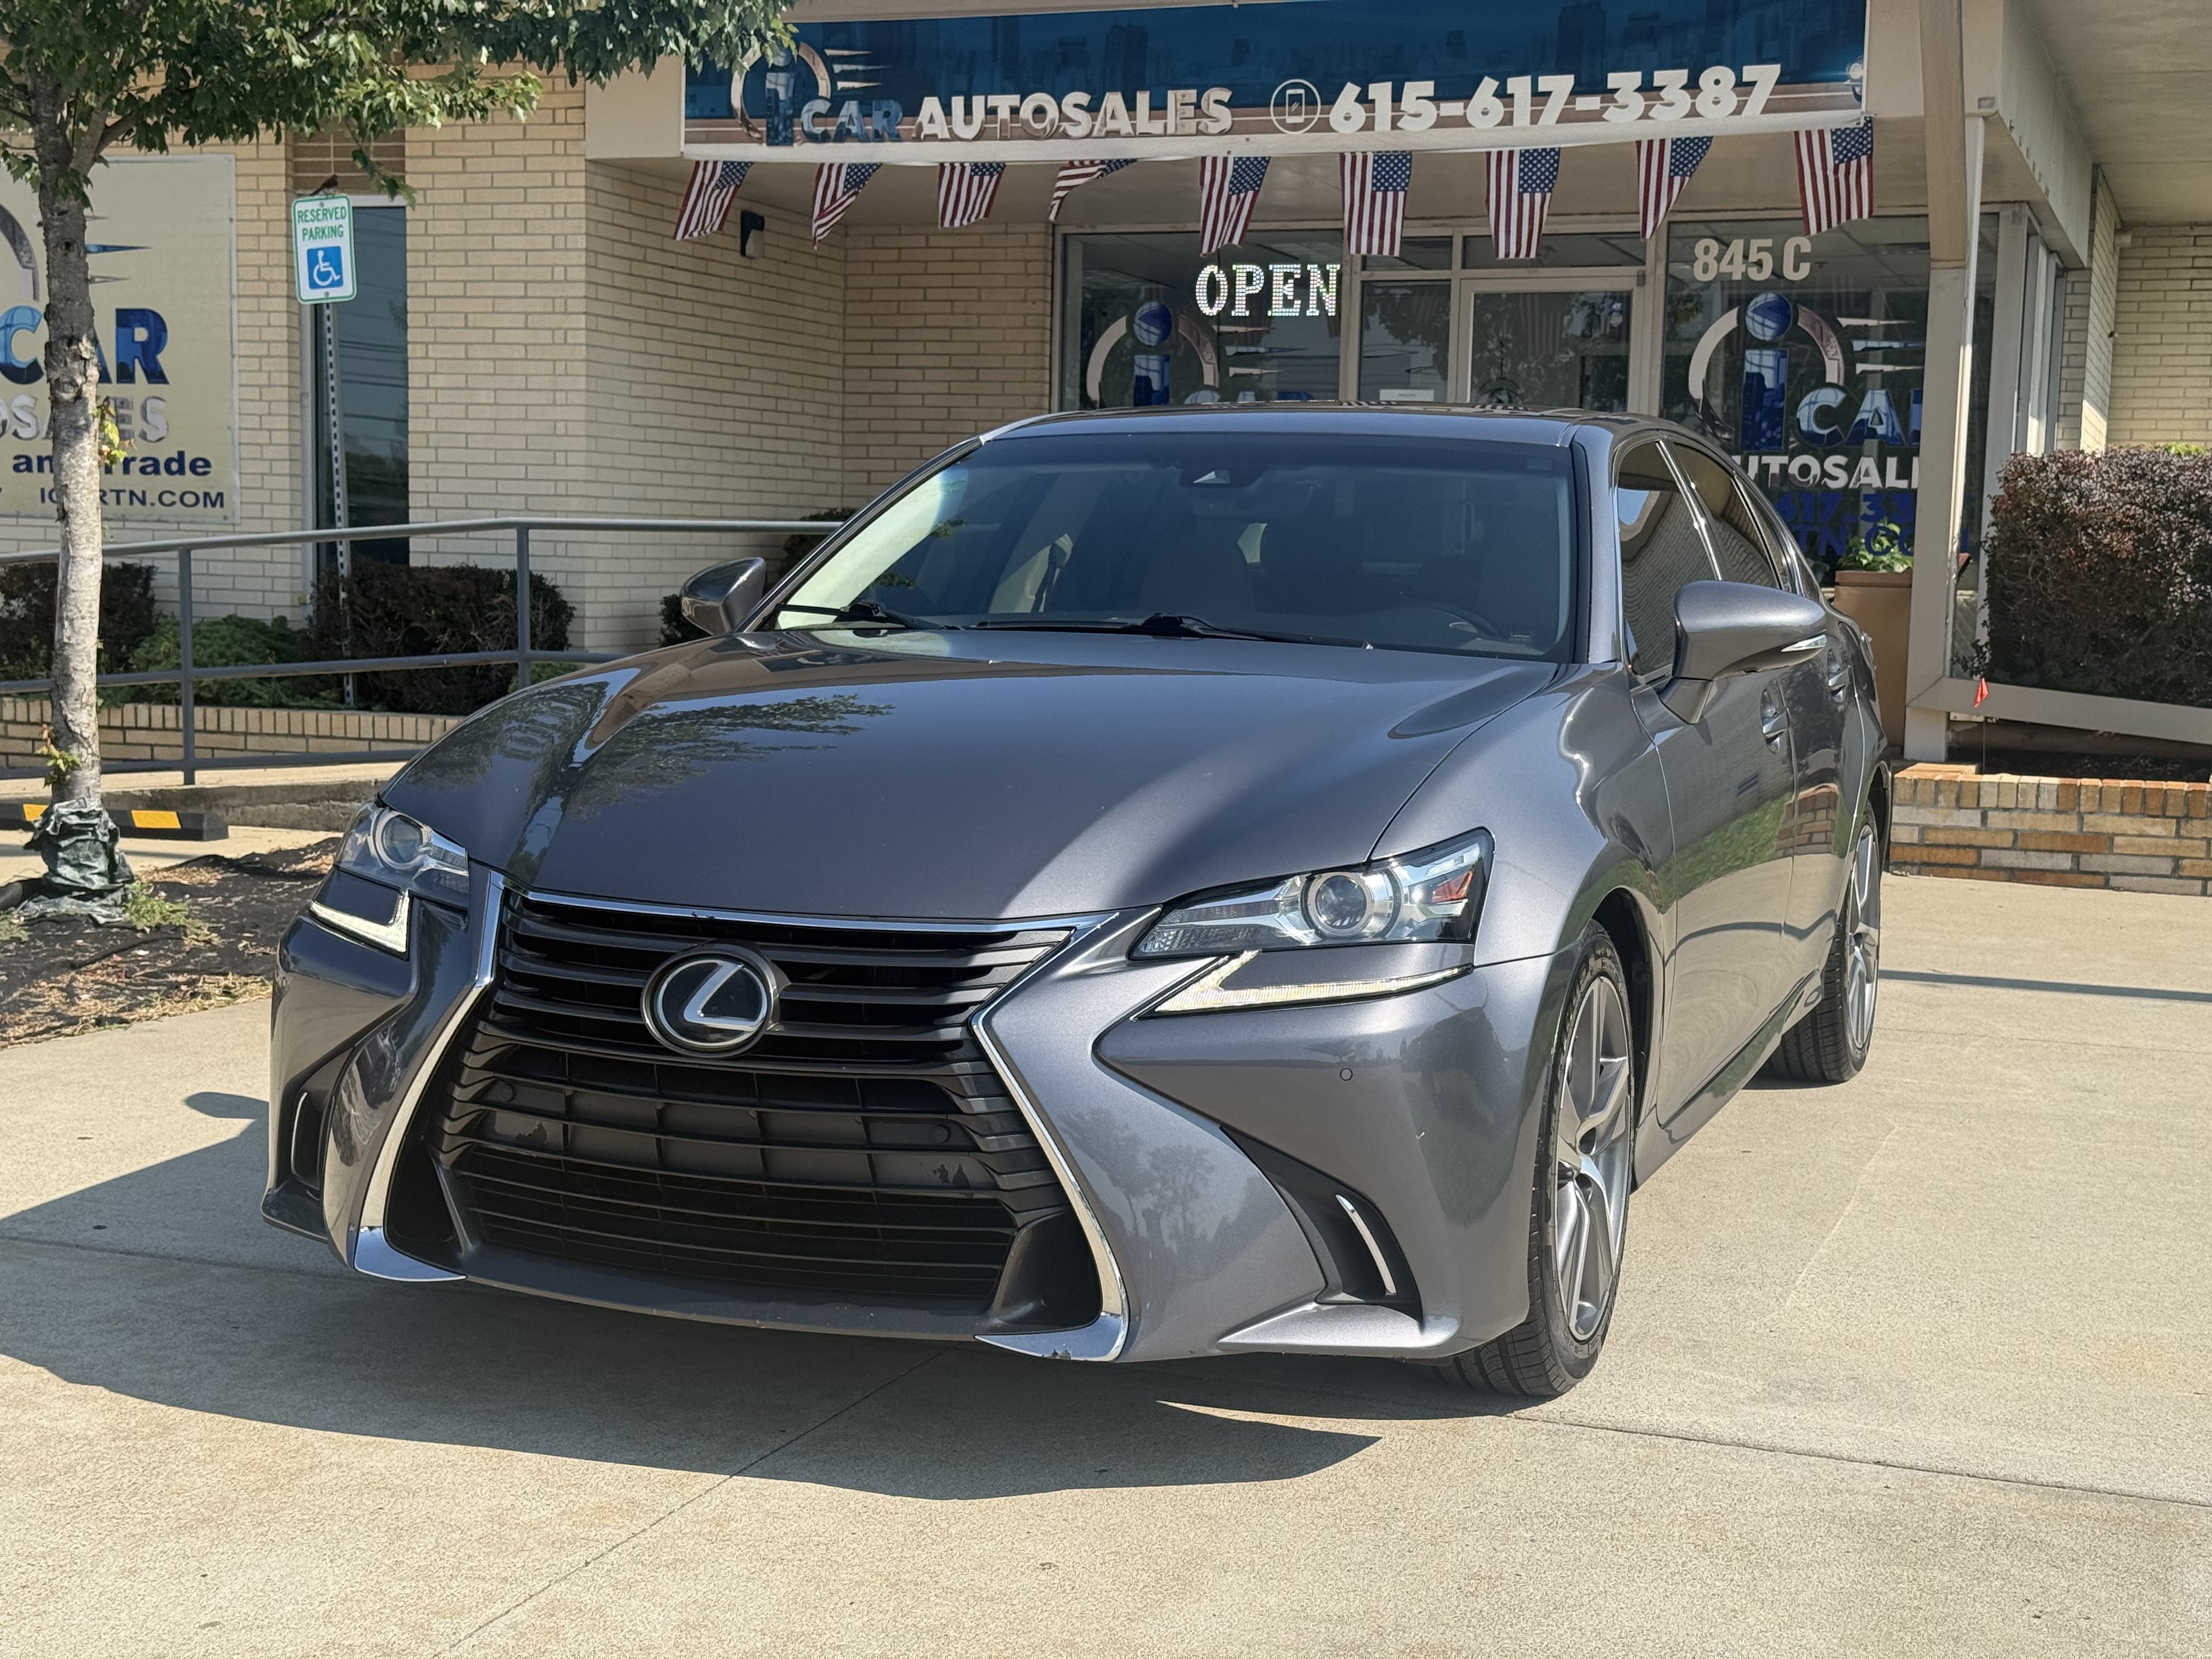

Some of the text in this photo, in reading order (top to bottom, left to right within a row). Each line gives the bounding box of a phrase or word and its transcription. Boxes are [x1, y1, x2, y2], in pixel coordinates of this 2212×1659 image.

[911, 87, 1233, 140] AUTOSALES
[1328, 63, 1782, 134] 615-617-3387
[297, 206, 347, 224] RESERVED
[302, 224, 344, 241] PARKING
[1693, 236, 1811, 282] 845 C
[1195, 264, 1341, 317] OPEN
[0, 304, 170, 385] CR
[1796, 386, 1922, 448] CA
[13, 454, 54, 473] an
[41, 487, 224, 508] IRTN.COM
